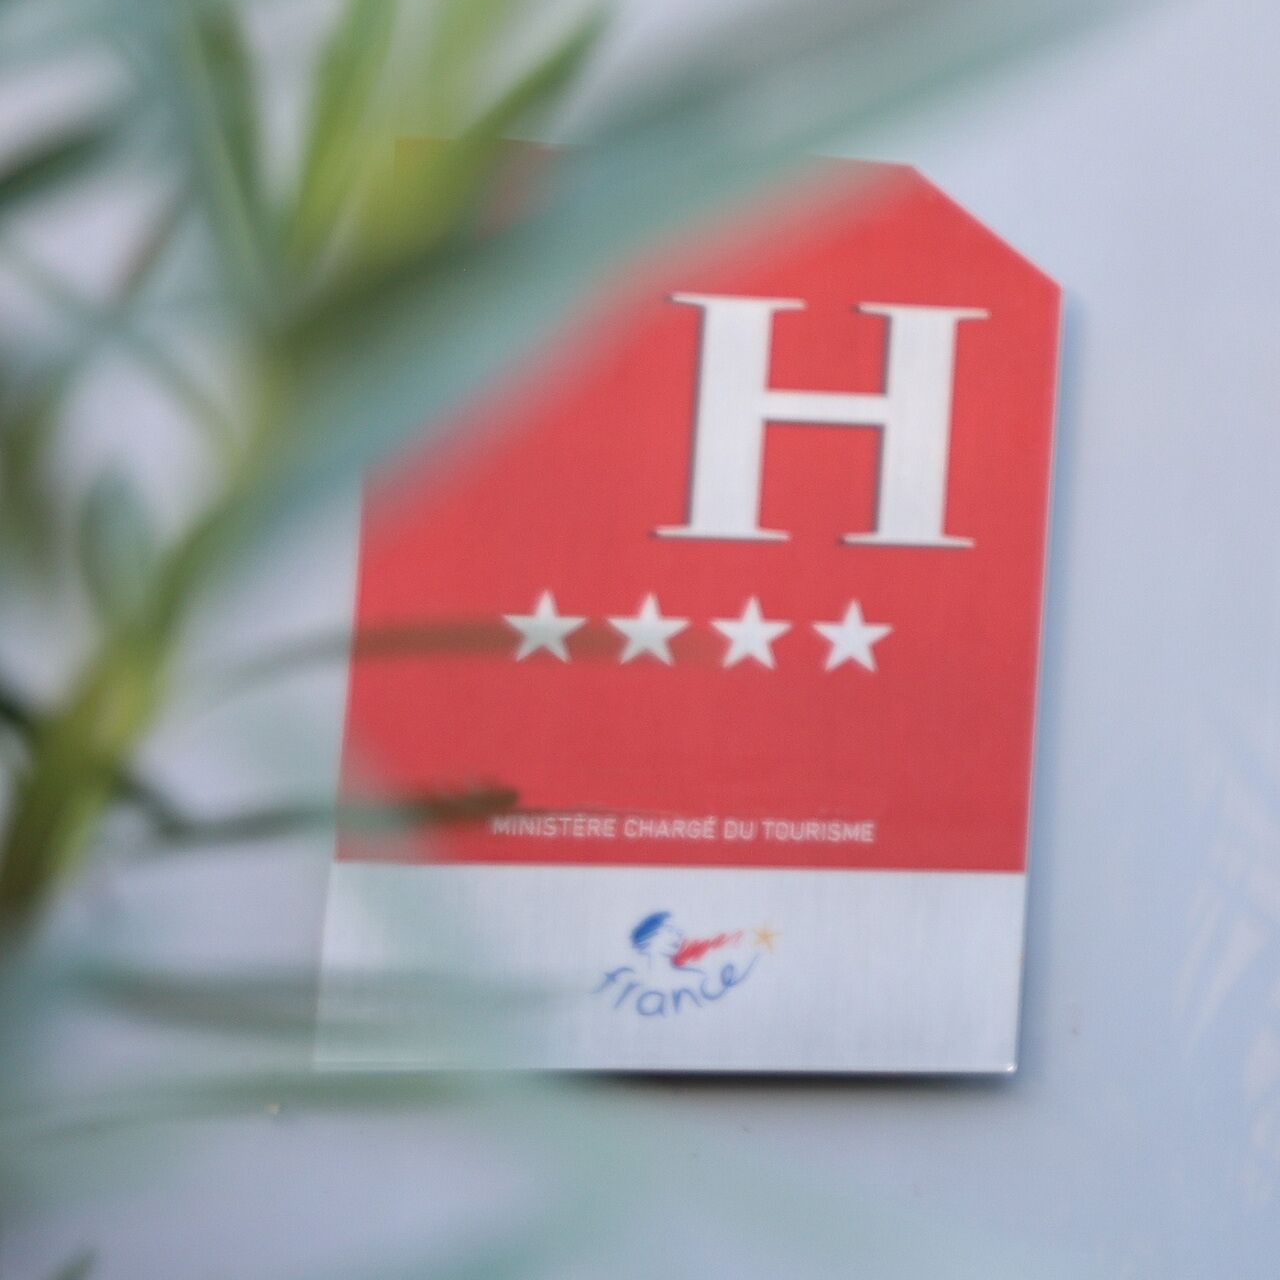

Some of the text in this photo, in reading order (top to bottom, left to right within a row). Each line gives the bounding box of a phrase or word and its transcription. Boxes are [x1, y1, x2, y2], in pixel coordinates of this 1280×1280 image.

[653, 291, 991, 550] H
[490, 814, 875, 843] MINISTÈRE CHARGÉ DU TOURISME
